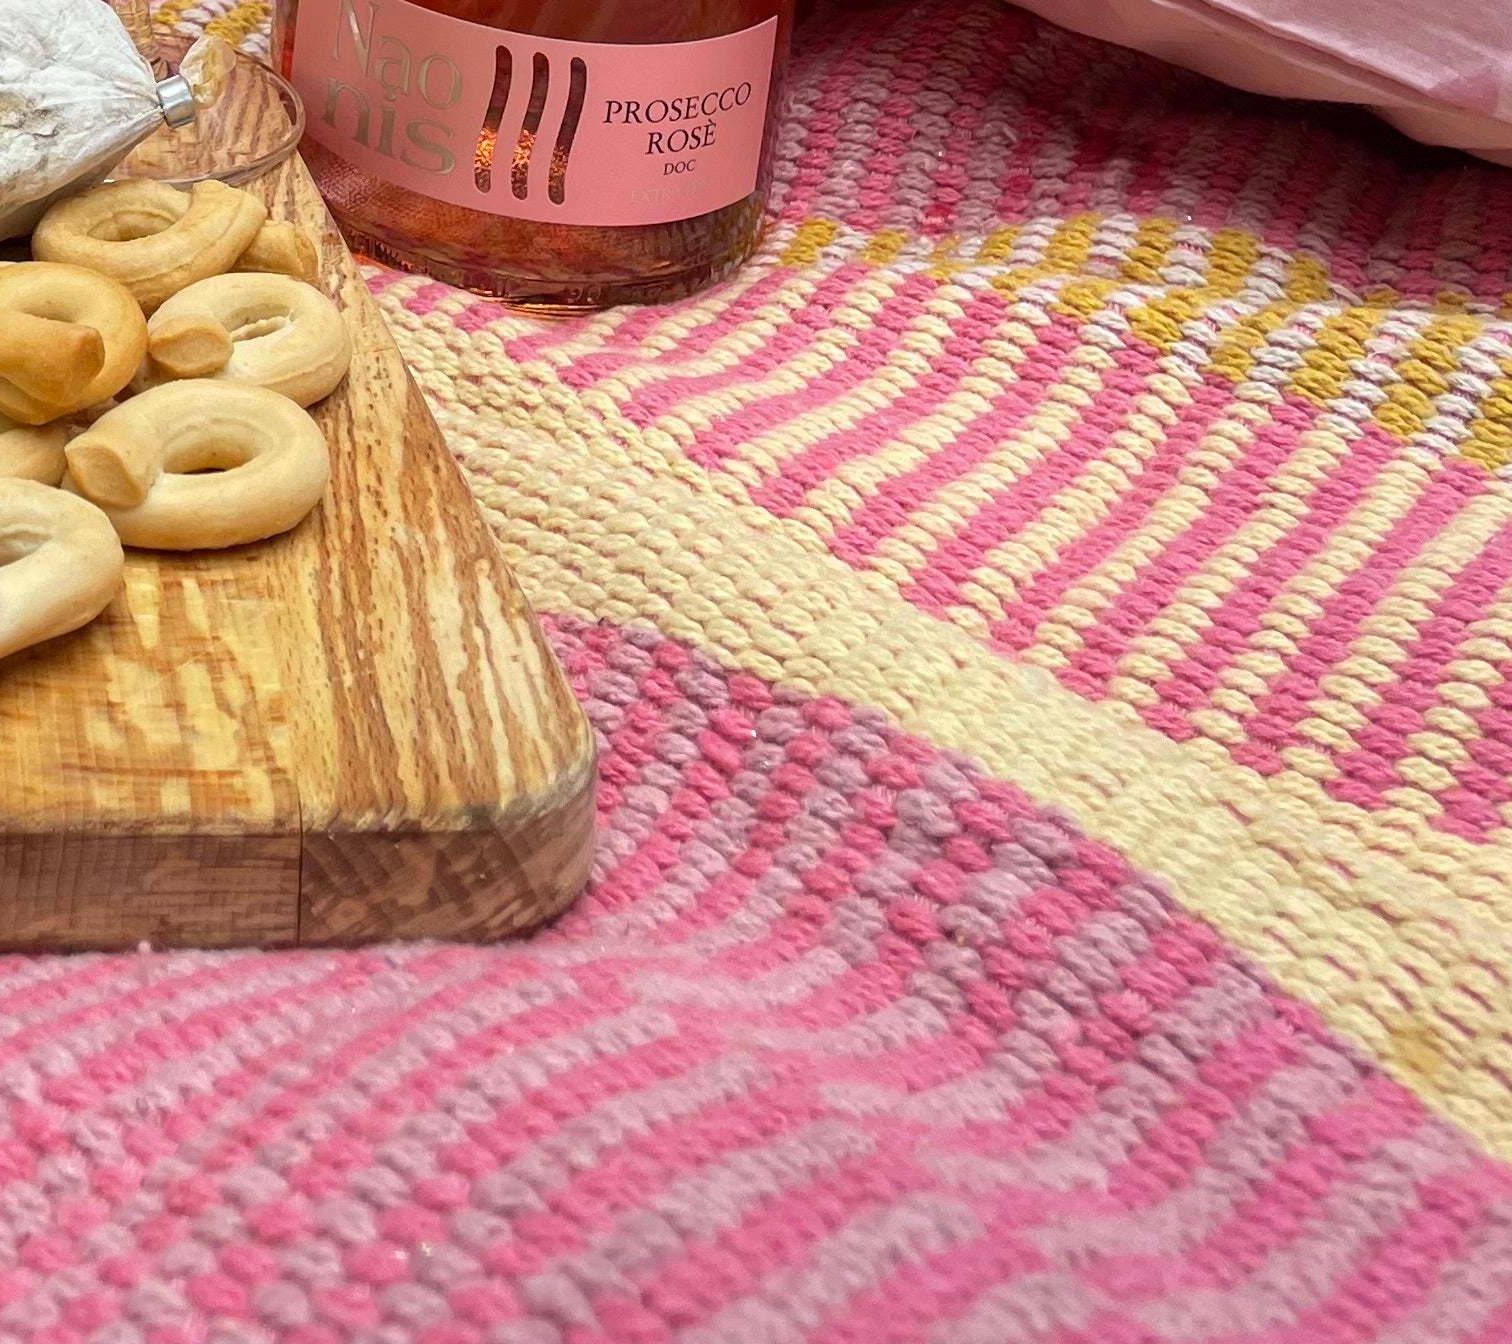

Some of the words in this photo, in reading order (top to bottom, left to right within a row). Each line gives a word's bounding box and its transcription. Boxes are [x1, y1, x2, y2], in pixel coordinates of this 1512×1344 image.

[602, 81, 752, 124] PROSECCO
[322, 76, 456, 176] nis
[663, 159, 696, 176] DOC
